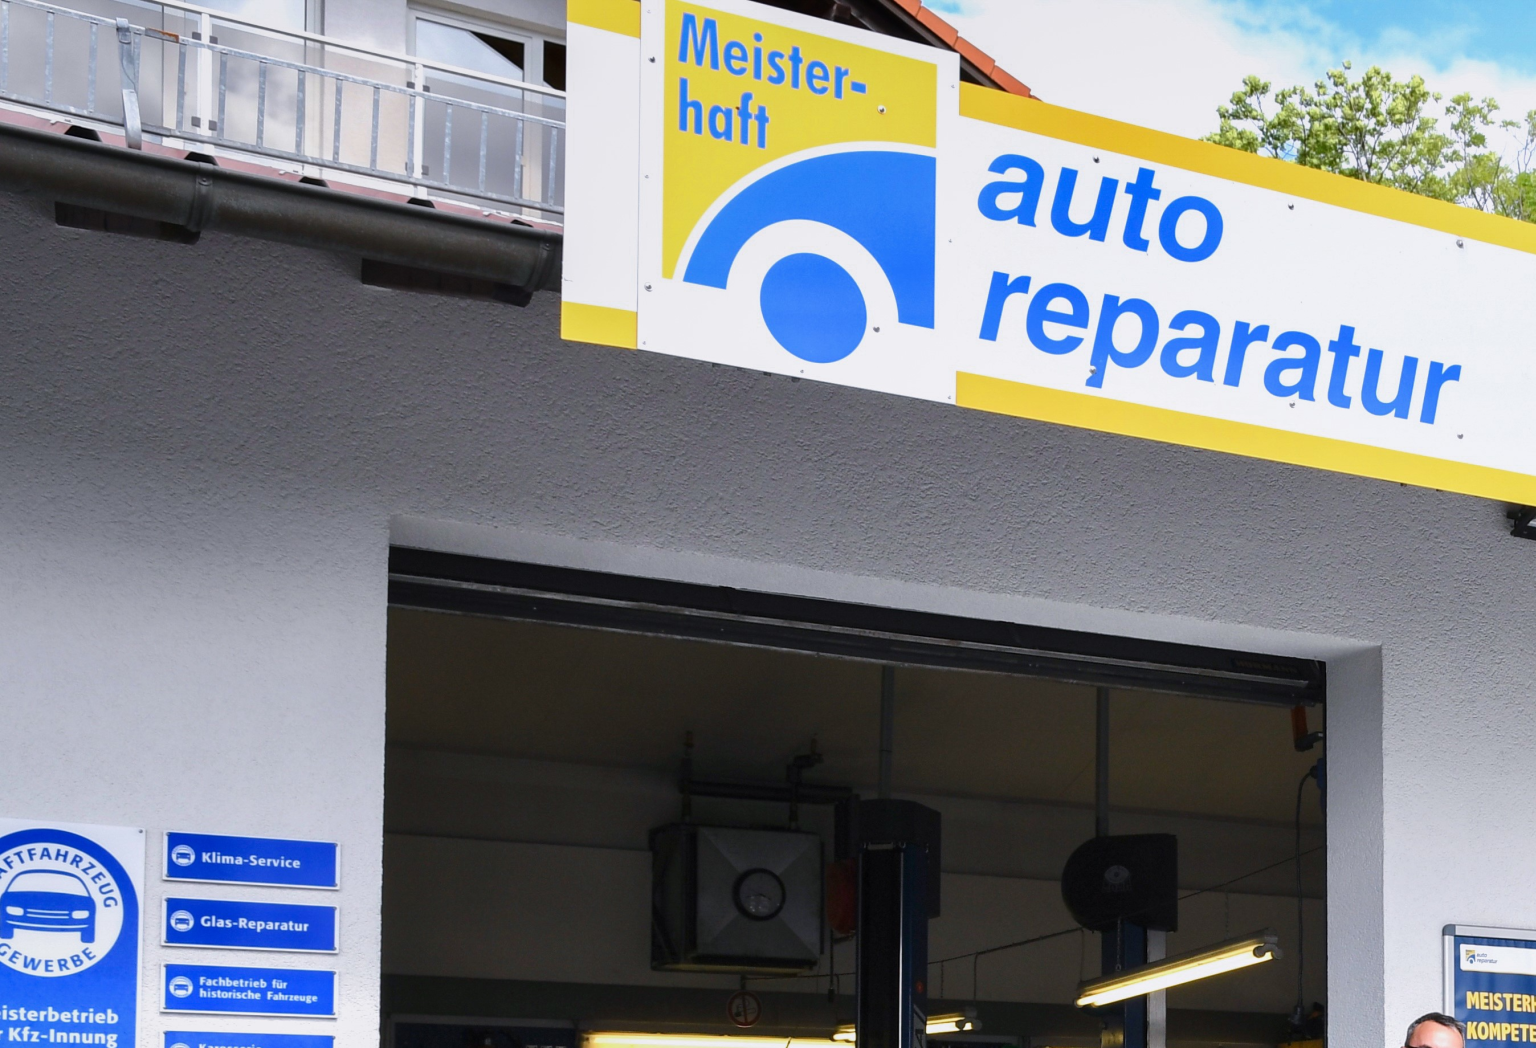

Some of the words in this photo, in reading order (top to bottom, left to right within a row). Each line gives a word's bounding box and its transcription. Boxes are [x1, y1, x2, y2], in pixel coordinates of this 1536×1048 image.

[677, 12, 867, 97] Meister-
[677, 77, 770, 149] haft
[976, 152, 1225, 263] auto
[978, 270, 1462, 426] reparatur
[202, 852, 301, 868] Klima-Service
[200, 915, 309, 932] Glas-Reparatur
[0, 943, 96, 972] GEWERBE
[199, 977, 267, 988] Fachbetrieb
[272, 979, 288, 989] für
[199, 988, 261, 1000] historische
[267, 991, 318, 1003] Fahrzeuge
[0, 1005, 118, 1024] isterbetrieb
[9, 1026, 118, 1048] Kfz-Innung
